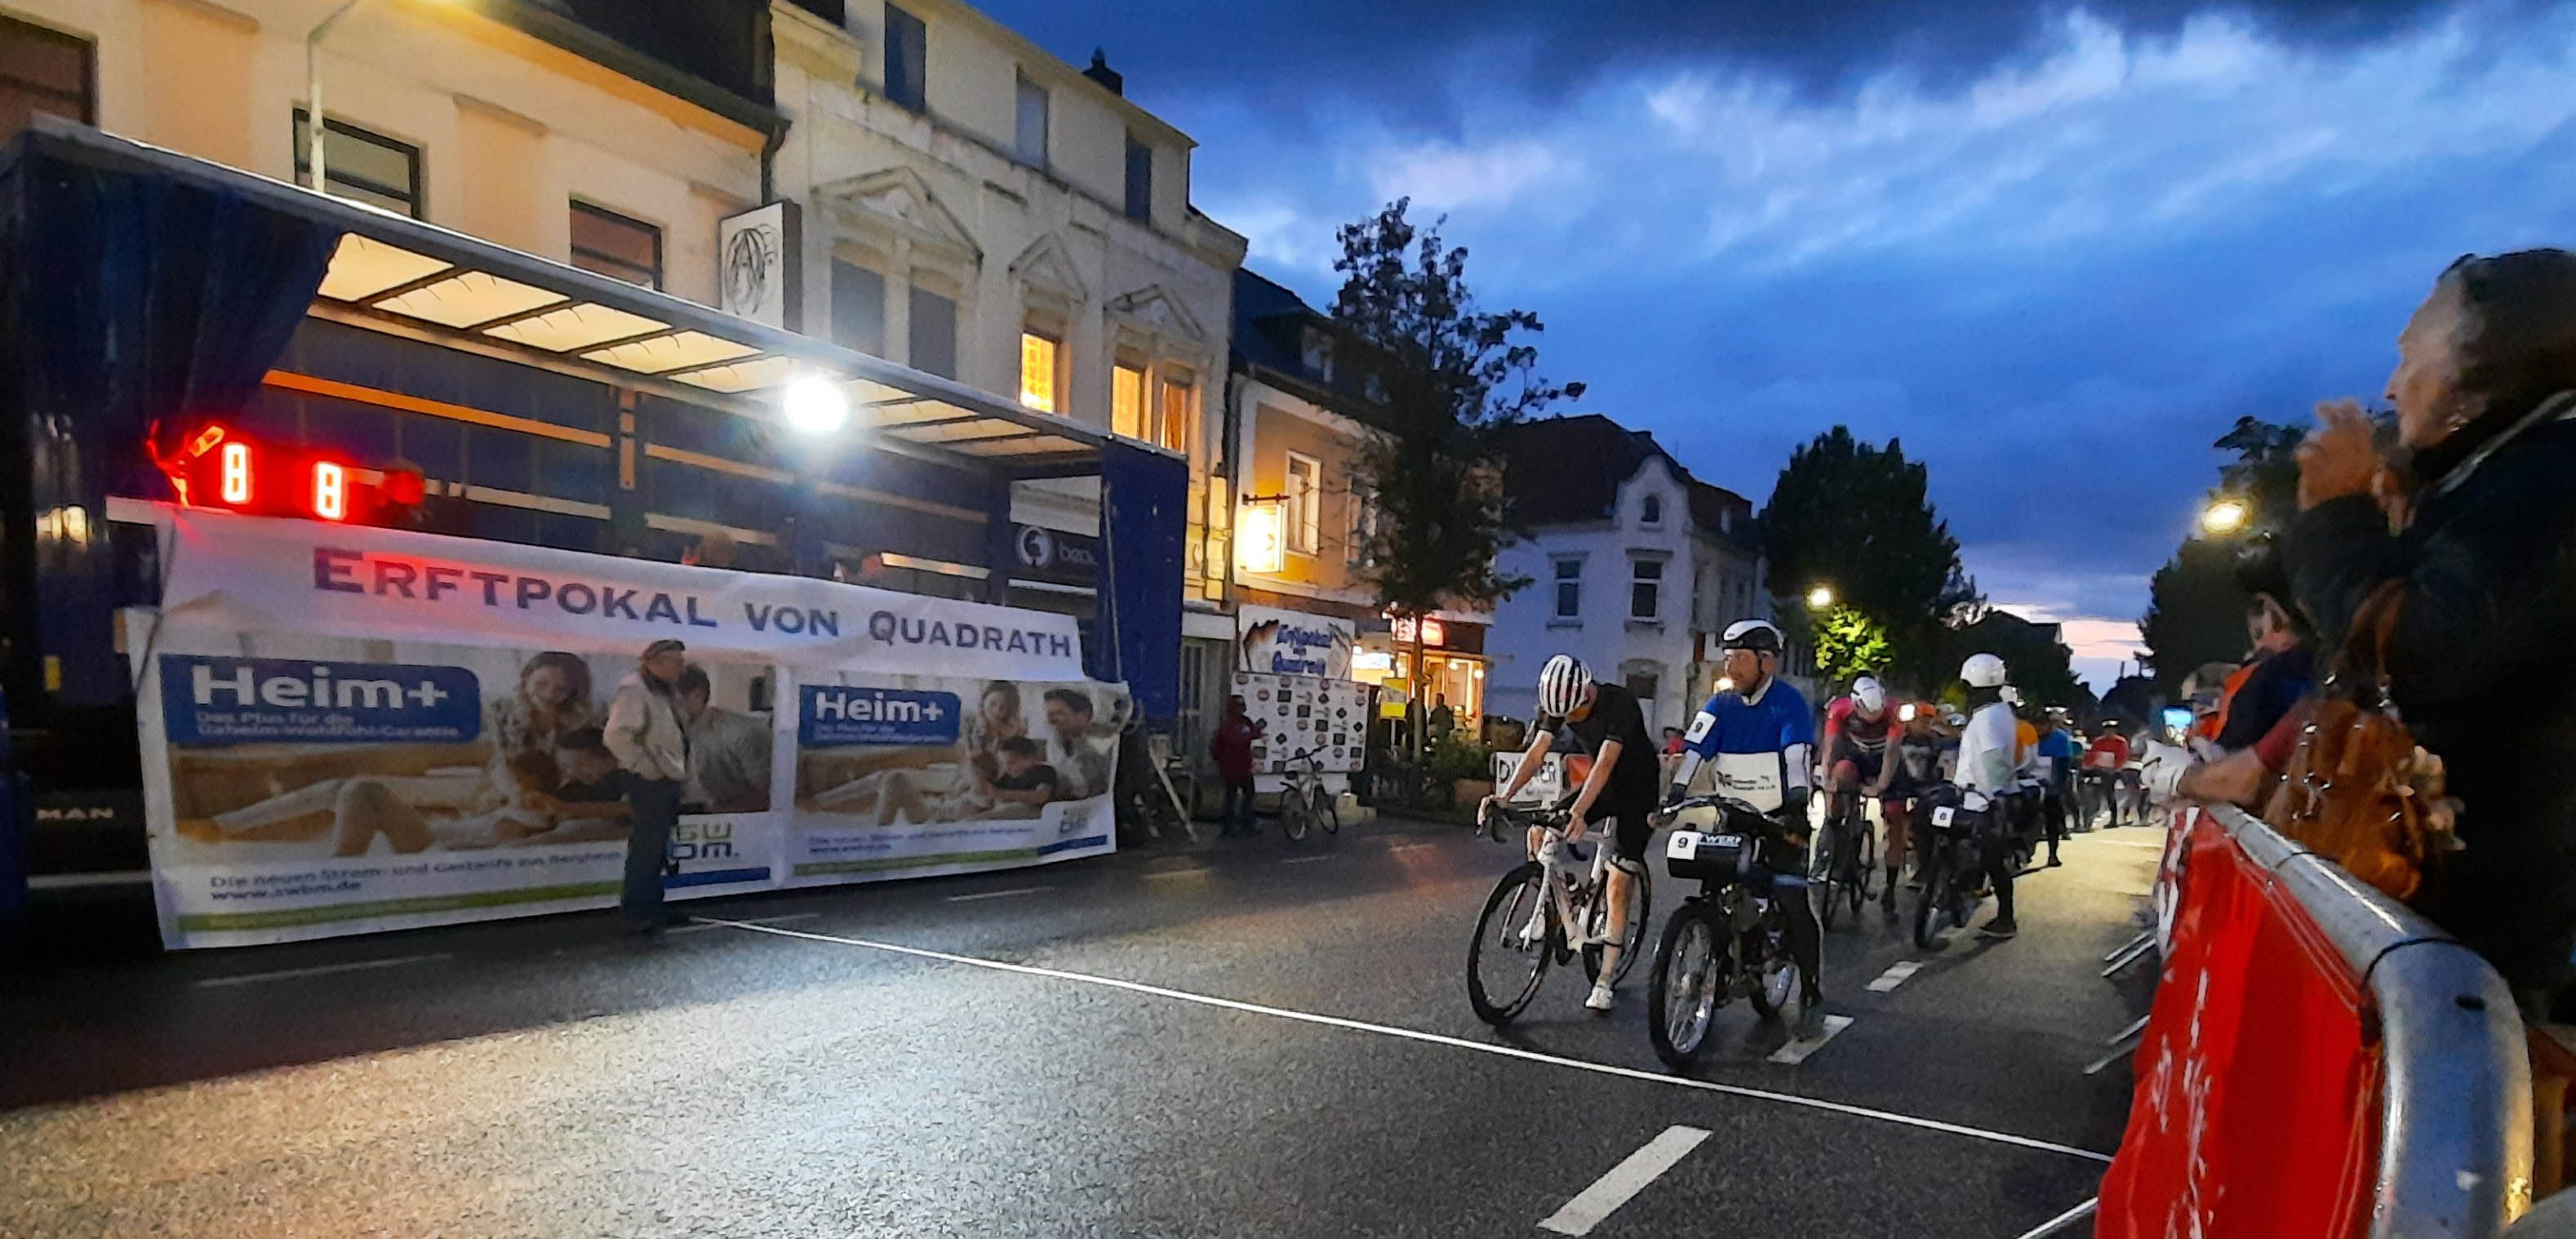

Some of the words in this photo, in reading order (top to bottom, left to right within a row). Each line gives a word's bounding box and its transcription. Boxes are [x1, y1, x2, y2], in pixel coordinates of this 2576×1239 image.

[313, 546, 717, 628] ERFTPOKAL
[744, 602, 840, 637] VON
[868, 610, 1073, 658] QUADRATH
[191, 664, 449, 709] Heim+
[816, 691, 944, 722] Heim+
[37, 807, 114, 819] MAN
[1677, 837, 1689, 848] 9
